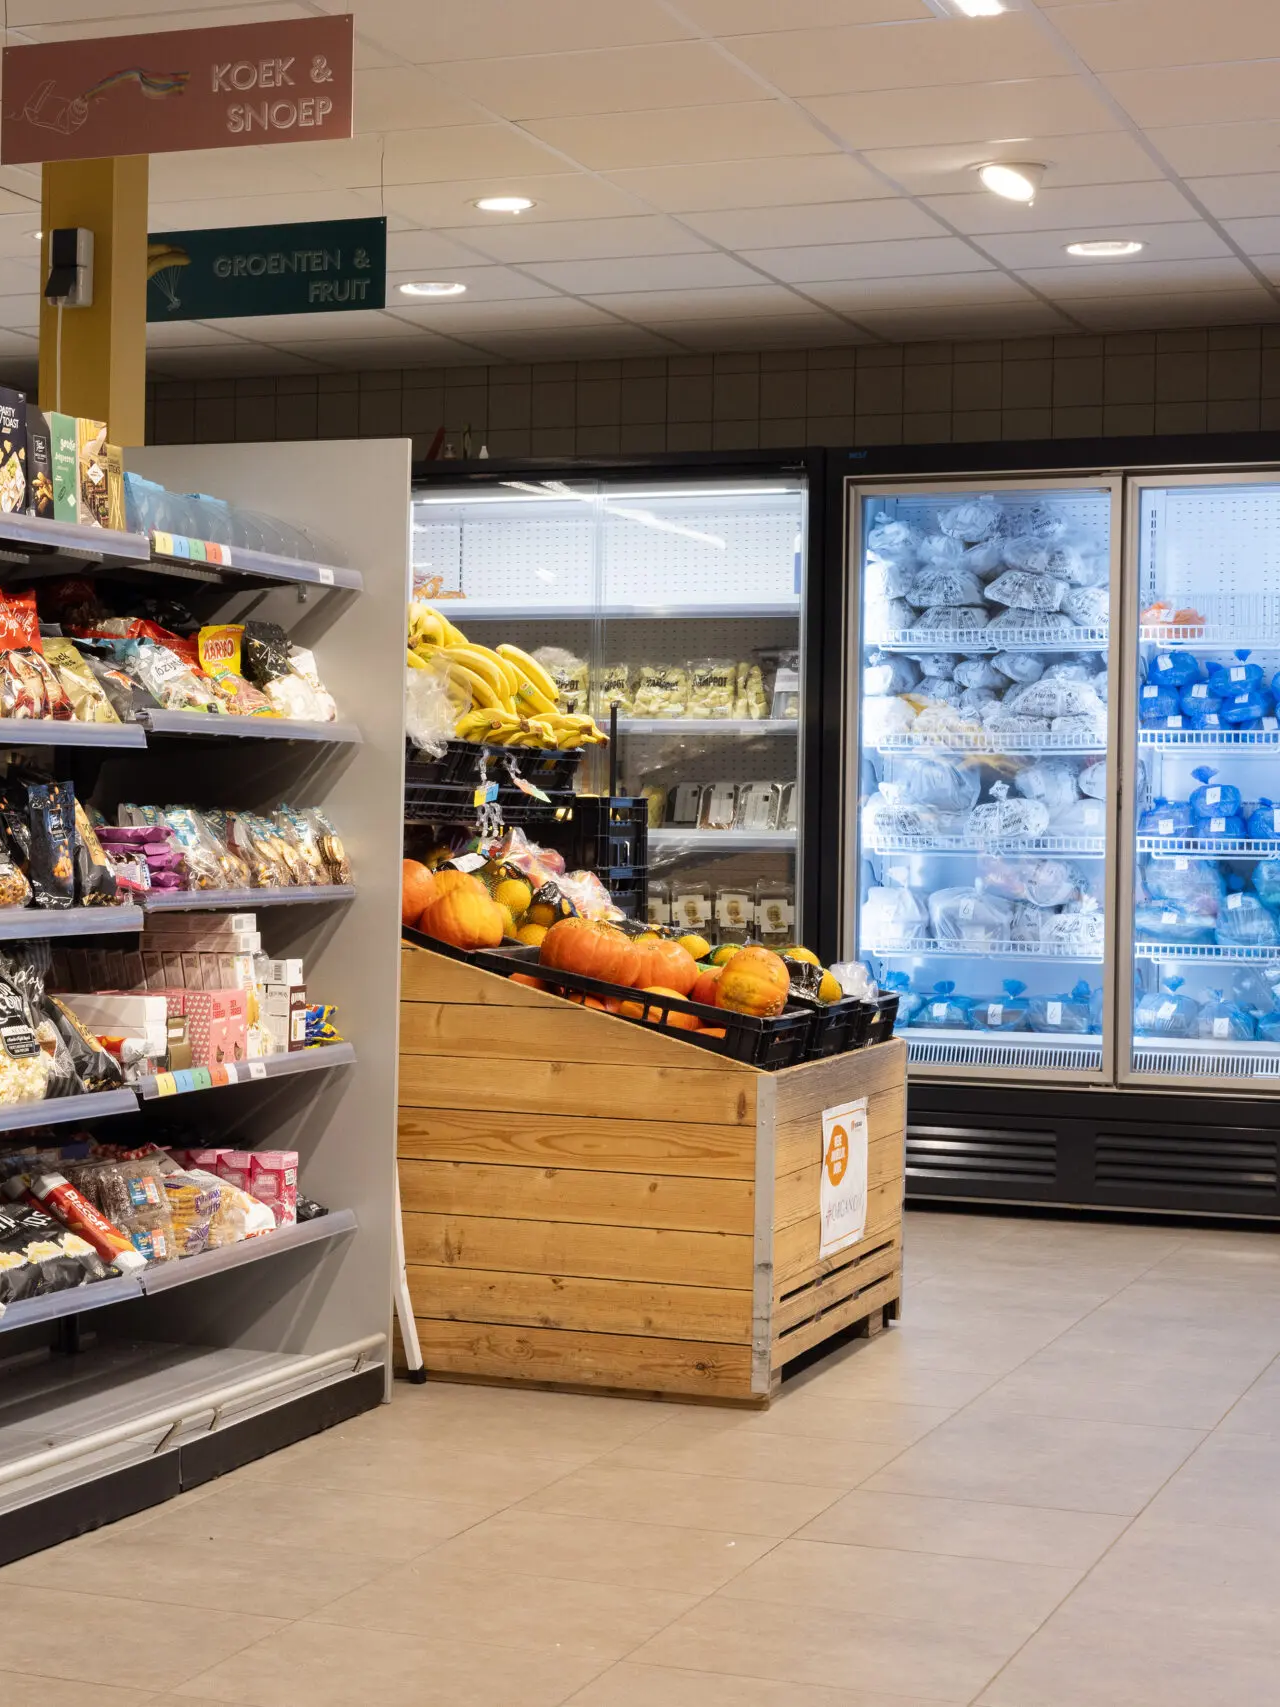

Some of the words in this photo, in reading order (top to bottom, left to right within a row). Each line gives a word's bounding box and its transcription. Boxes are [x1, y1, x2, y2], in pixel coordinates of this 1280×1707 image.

[211, 57, 297, 92] KOEK
[310, 54, 334, 83] &
[226, 95, 333, 132] SNOEP
[213, 248, 341, 277] GROENTEN
[353, 248, 372, 269] &
[308, 278, 371, 303] FRUIT
[2, 416, 20, 429] TOAST
[64, 1190, 110, 1231] Biscoff
